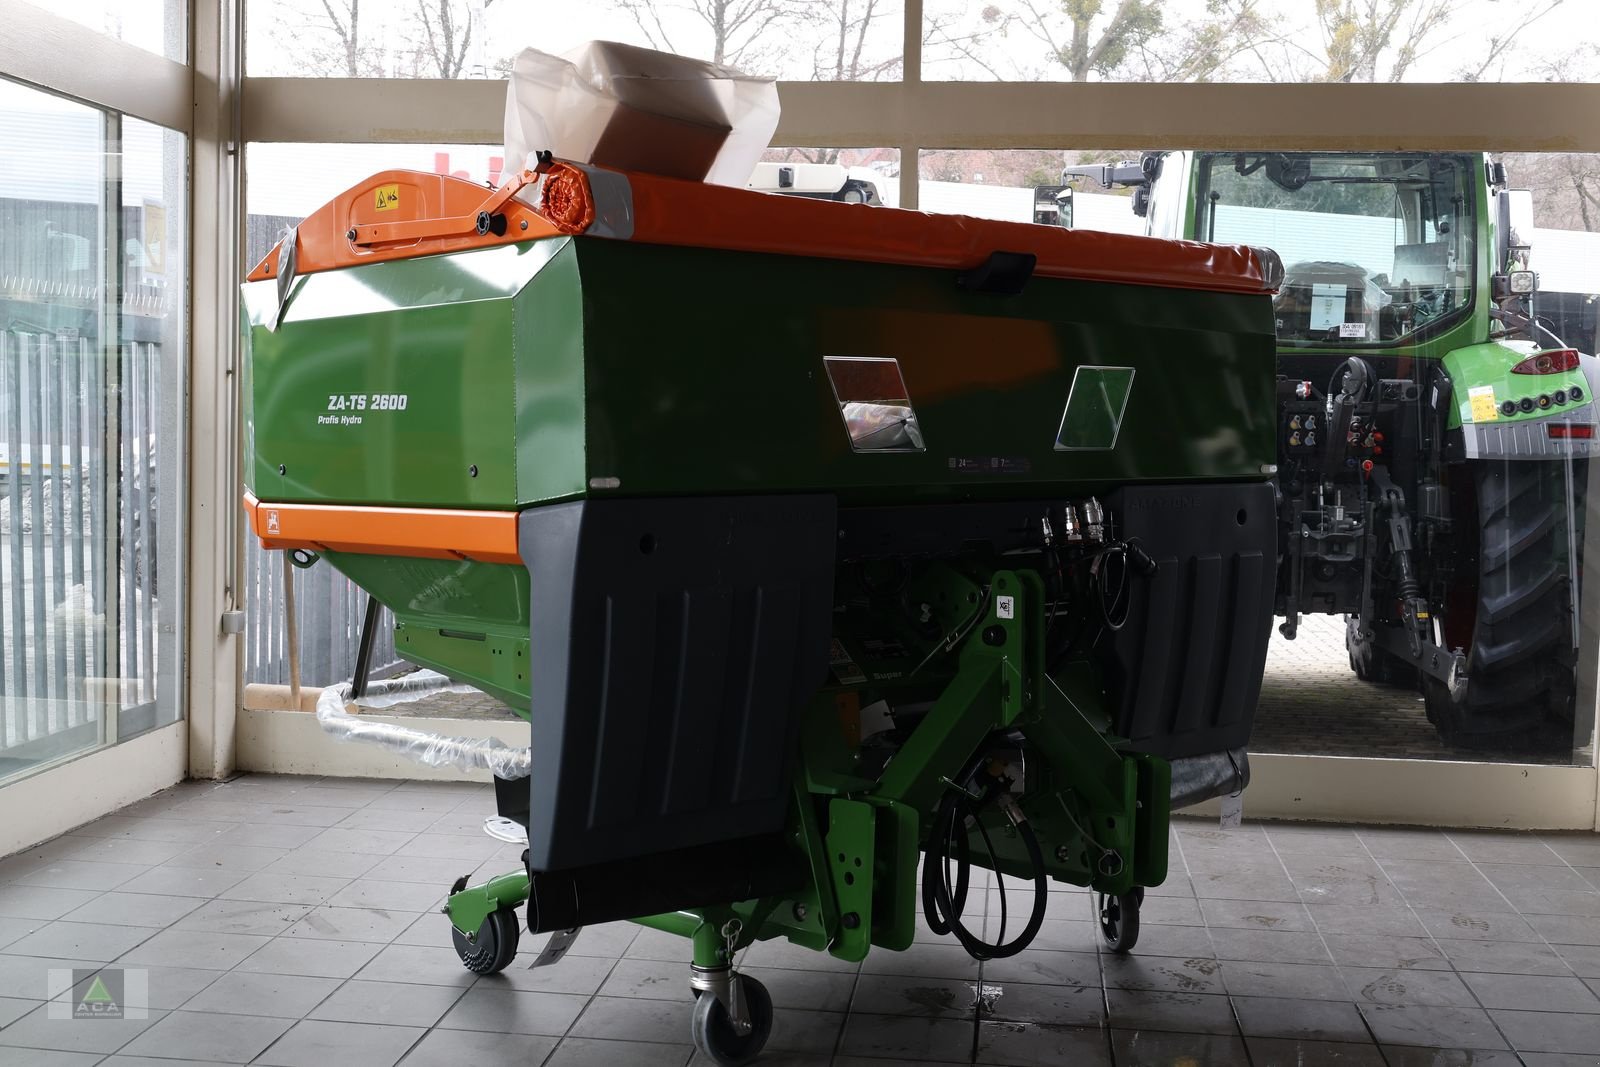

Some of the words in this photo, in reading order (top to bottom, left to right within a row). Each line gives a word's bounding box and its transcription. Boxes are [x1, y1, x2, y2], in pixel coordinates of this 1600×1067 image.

[328, 395, 367, 410] ZA-TS
[370, 394, 408, 410] 2600
[318, 415, 339, 425] Profis
[341, 415, 362, 426] Hydro
